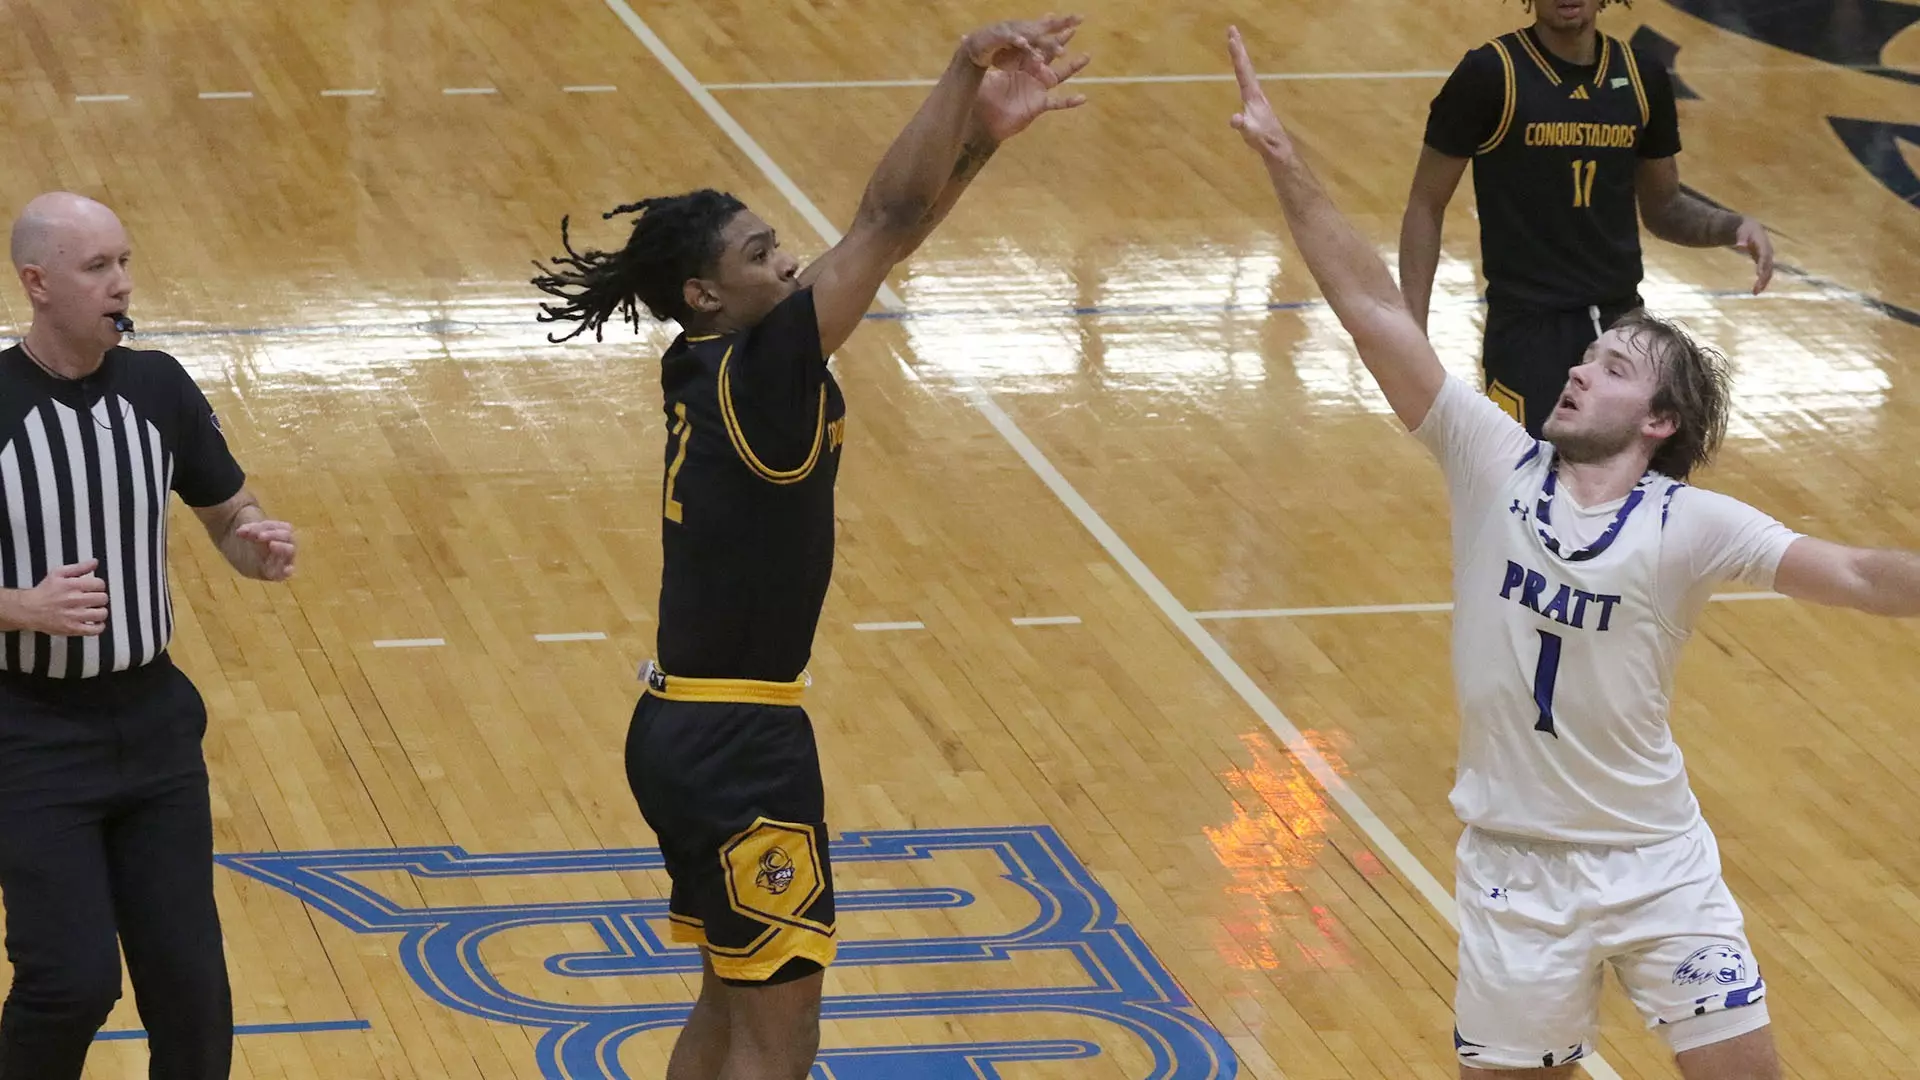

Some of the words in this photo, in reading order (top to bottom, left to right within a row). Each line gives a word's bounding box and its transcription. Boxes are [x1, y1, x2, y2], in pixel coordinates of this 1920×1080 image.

[1524, 122, 1637, 148] CONQUISTADORS
[1571, 159, 1597, 208] 11
[1499, 559, 1622, 632] PRATT
[1533, 628, 1563, 740] 1
